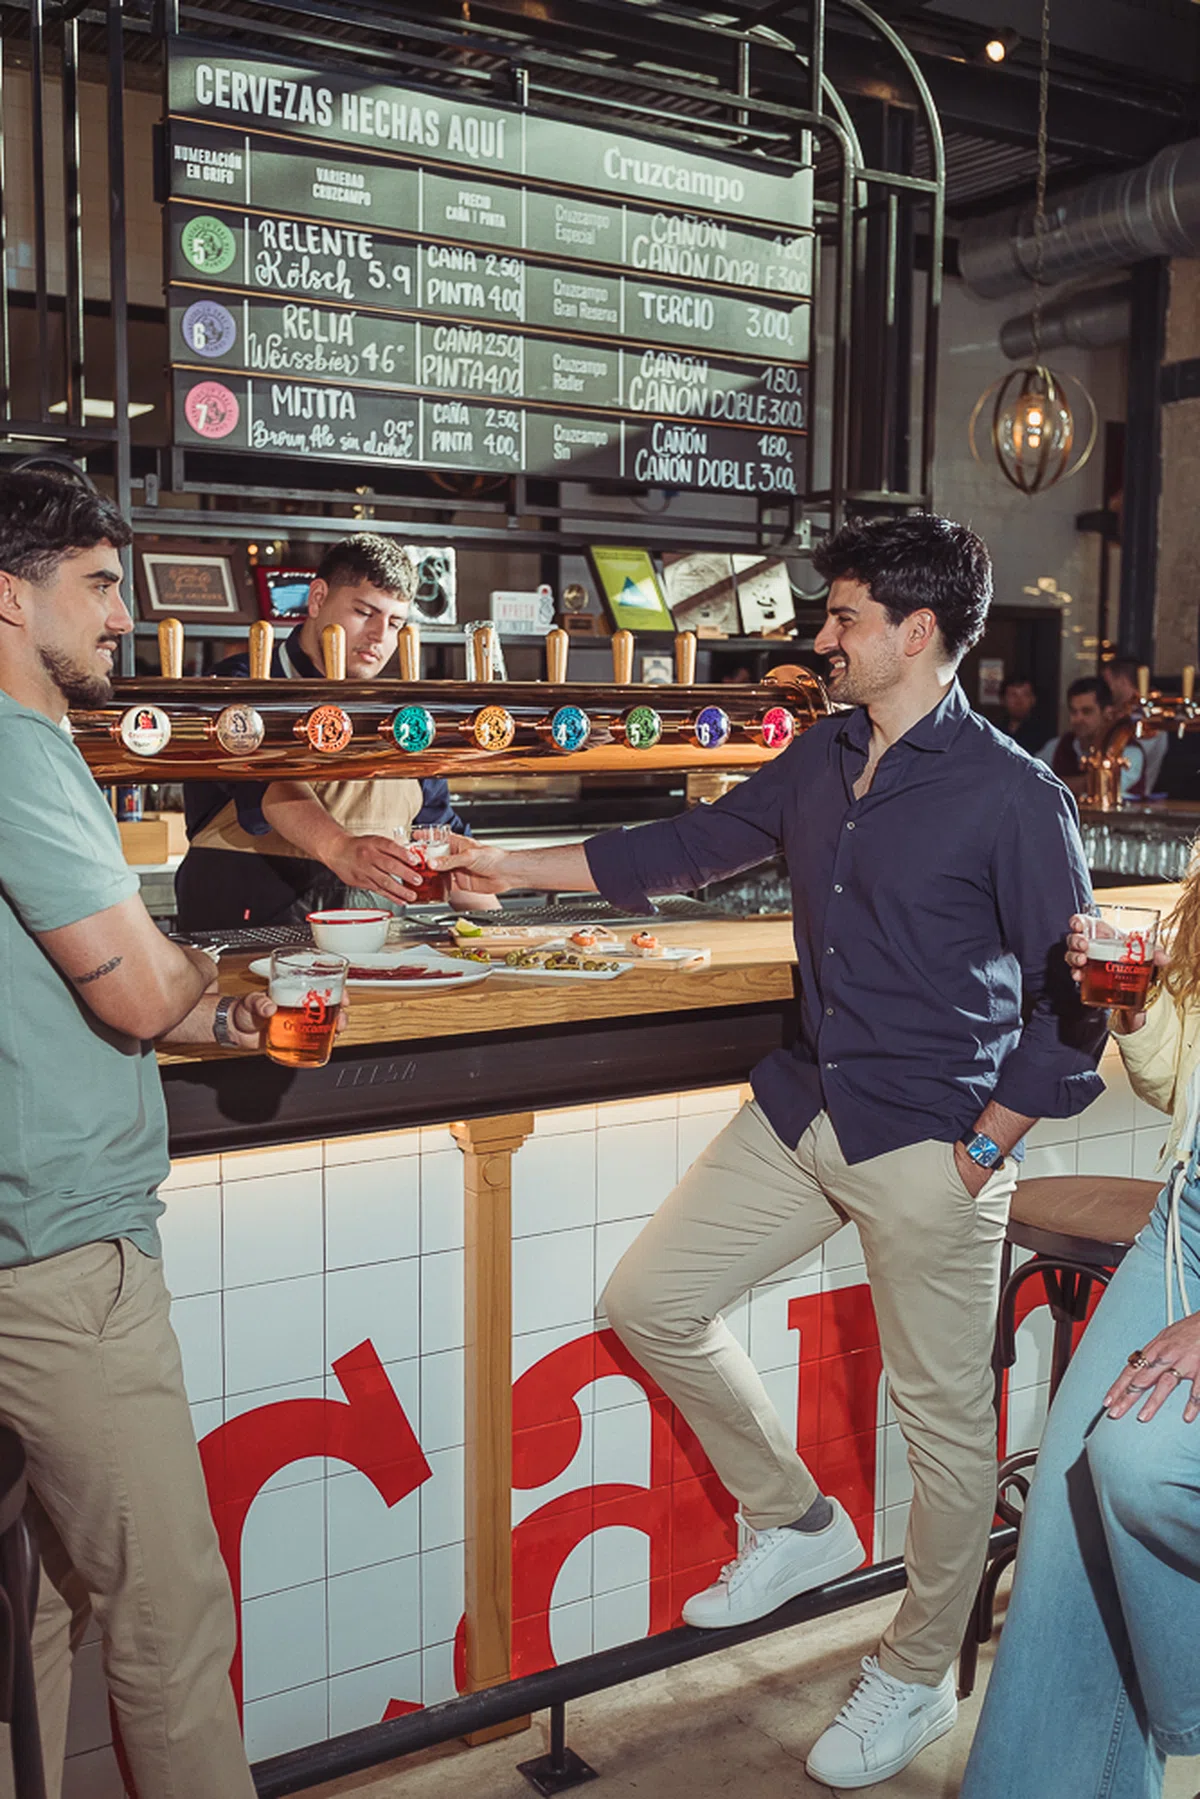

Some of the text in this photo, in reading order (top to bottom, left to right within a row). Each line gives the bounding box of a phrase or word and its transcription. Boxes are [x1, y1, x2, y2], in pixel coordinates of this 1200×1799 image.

[196, 64, 507, 159] CERVEZAS HECHAS AQUÍ
[174, 145, 242, 170] NUMERACIÓN
[187, 163, 234, 184] EN GRIFO
[316, 167, 365, 189] VARIEDAD
[603, 146, 745, 203] Cruzcampo
[312, 183, 371, 206] CRUZCAMPO
[555, 203, 610, 229] Cruzcampo
[193, 238, 205, 265] 5
[258, 219, 374, 260] RELENTE
[427, 245, 478, 272] CAÑA
[255, 250, 412, 300] Kölsch 5.9
[427, 278, 486, 308] PINTA
[553, 278, 609, 305] Cruzcampo
[553, 298, 578, 318] Gran
[638, 291, 714, 331] TERCIO
[193, 322, 206, 349] 6
[434, 324, 484, 356] CAÑA
[248, 332, 360, 376] Weissbier
[553, 352, 608, 378] Cruzcampo
[422, 354, 485, 390] PINTA
[271, 384, 357, 420] MIJITA
[433, 401, 470, 426] CAÑA
[629, 376, 709, 417] CAÑÓN
[711, 388, 768, 425] DOBLE
[195, 403, 208, 431] 7
[309, 424, 336, 448] Ale
[431, 430, 473, 453] PINTA
[553, 423, 609, 449] Cruzcampo
[652, 421, 708, 455] CAÑÓN
[634, 448, 692, 483] CAÑÓN
[698, 457, 756, 491] DOBLE
[399, 722, 410, 747] 2
[556, 724, 567, 746] 4
[630, 724, 640, 745] 5
[699, 723, 710, 746] 6
[763, 724, 774, 745] 7
[1105, 961, 1151, 975] Cruzca
